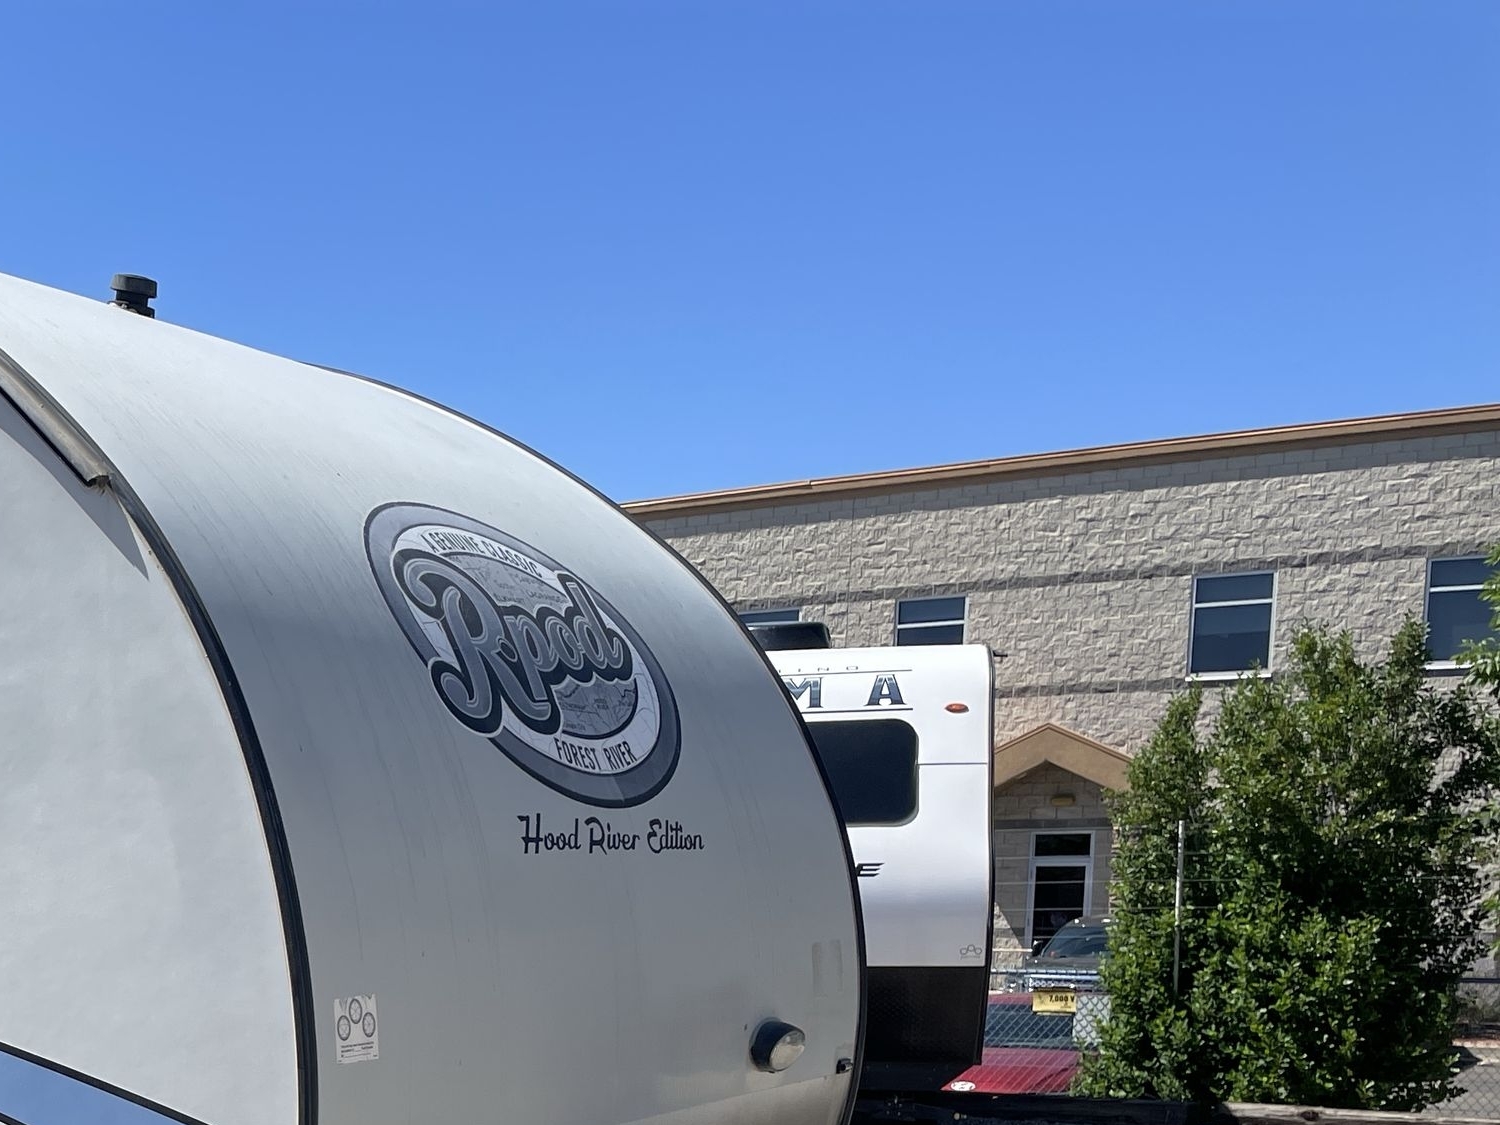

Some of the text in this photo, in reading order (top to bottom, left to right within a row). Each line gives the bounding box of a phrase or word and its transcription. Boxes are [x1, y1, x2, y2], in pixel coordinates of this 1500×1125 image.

[428, 532, 485, 553] GENUINE
[481, 540, 543, 578] CLASSIC
[553, 737, 637, 771] FOREST RIVER
[517, 813, 704, 855] Hood River Edition
